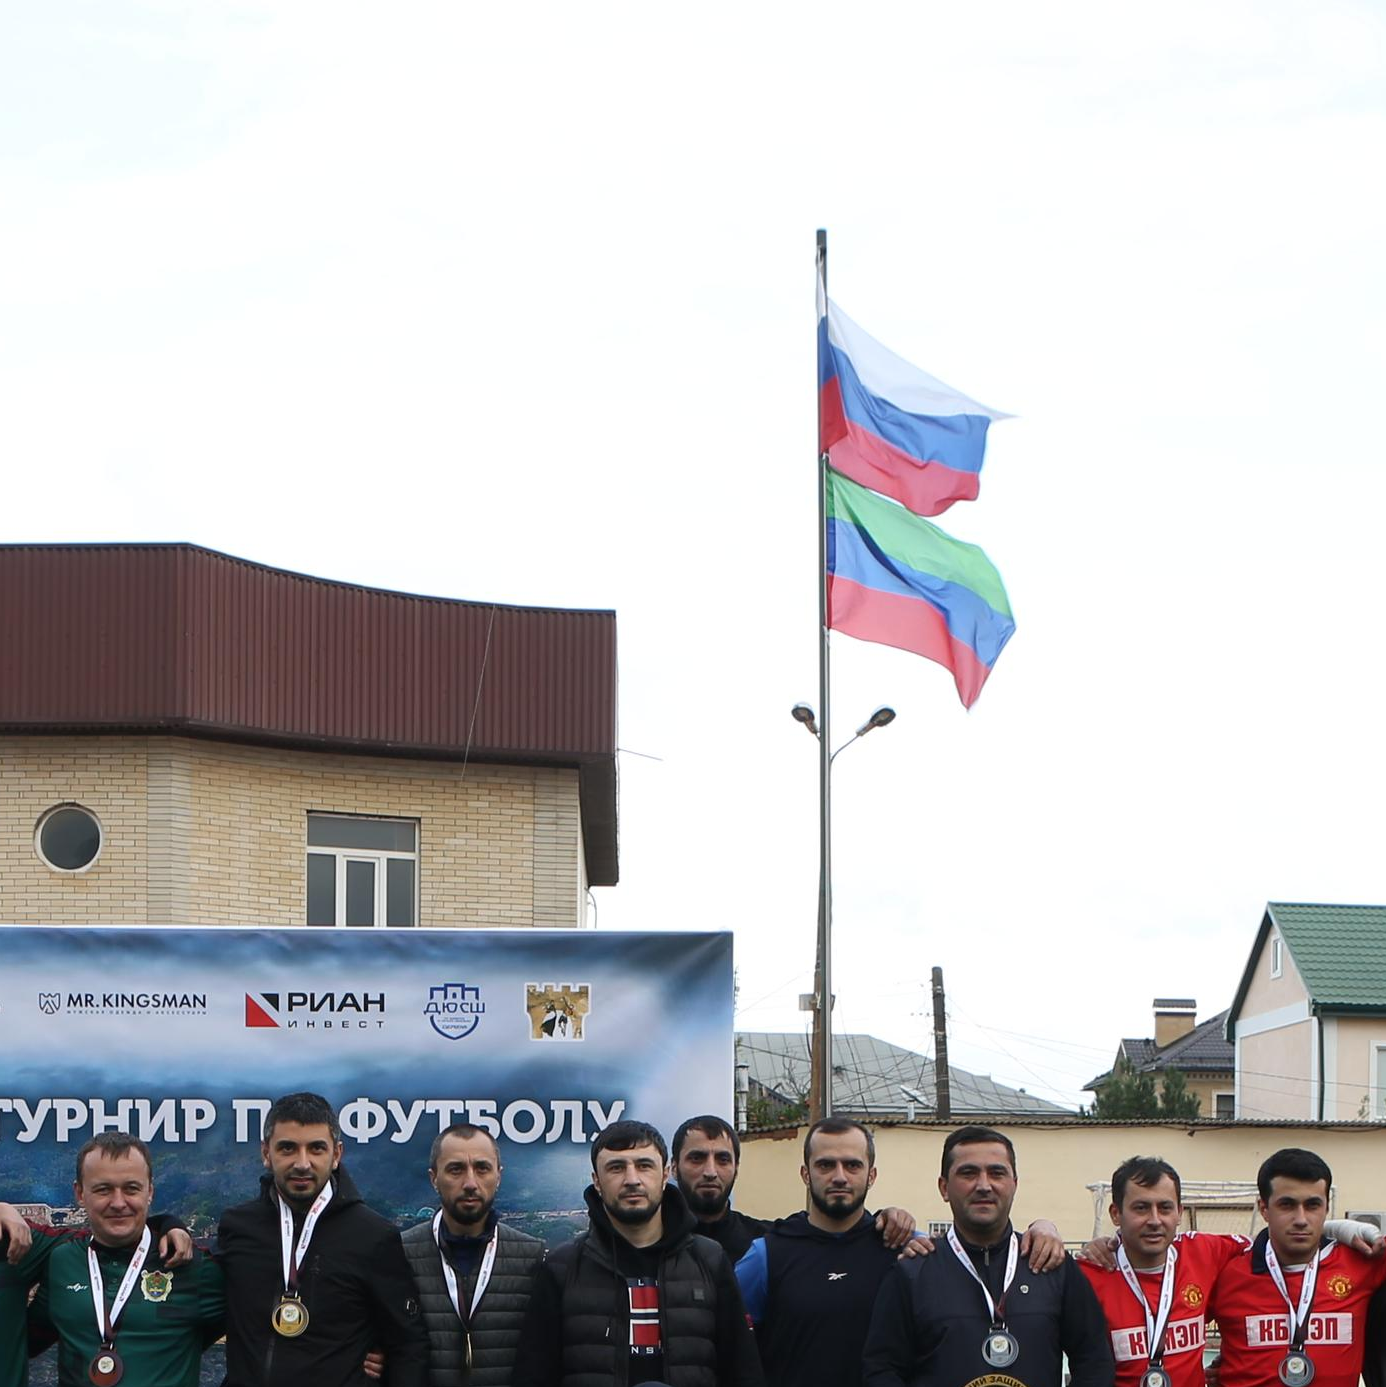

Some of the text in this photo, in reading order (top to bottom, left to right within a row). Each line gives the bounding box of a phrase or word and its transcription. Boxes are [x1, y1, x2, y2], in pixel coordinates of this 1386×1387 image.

[287, 992, 385, 1012] РИАН
[423, 1002, 486, 1015] ДЮСШ
[288, 1020, 385, 1029] ИНВЕСТ
[1128, 1318, 1200, 1355] КМЭП
[1259, 1317, 1338, 1342] КБЭП
